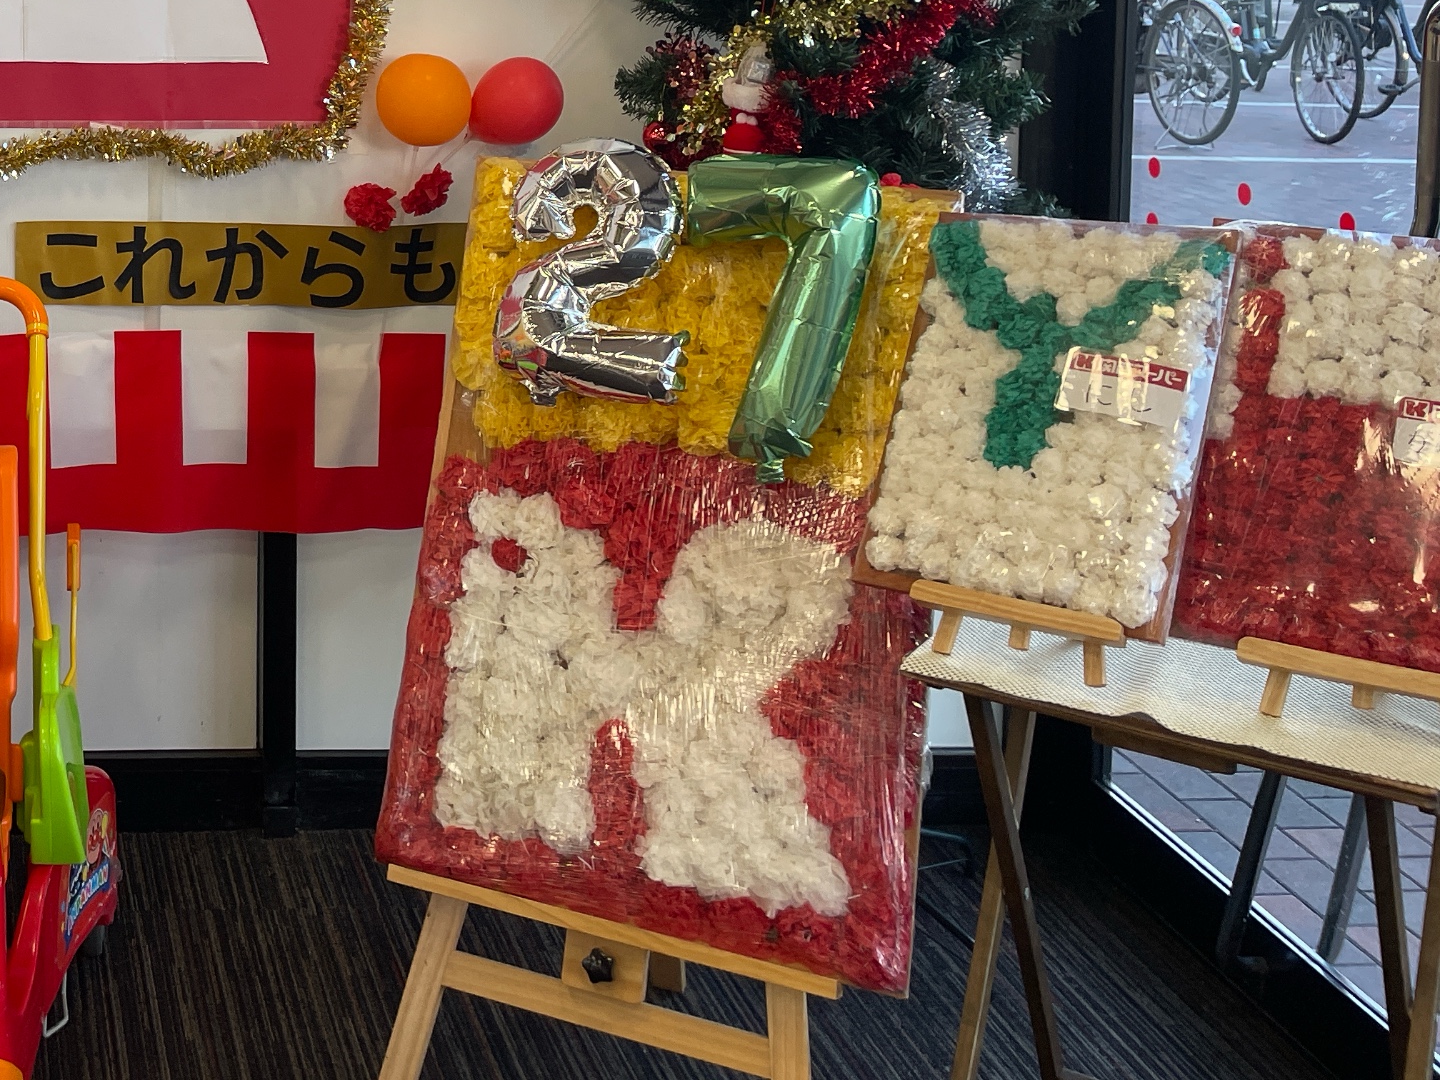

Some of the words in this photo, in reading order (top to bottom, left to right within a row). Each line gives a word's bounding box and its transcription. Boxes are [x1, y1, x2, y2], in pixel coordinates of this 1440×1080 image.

[40, 227, 456, 309] これからも
